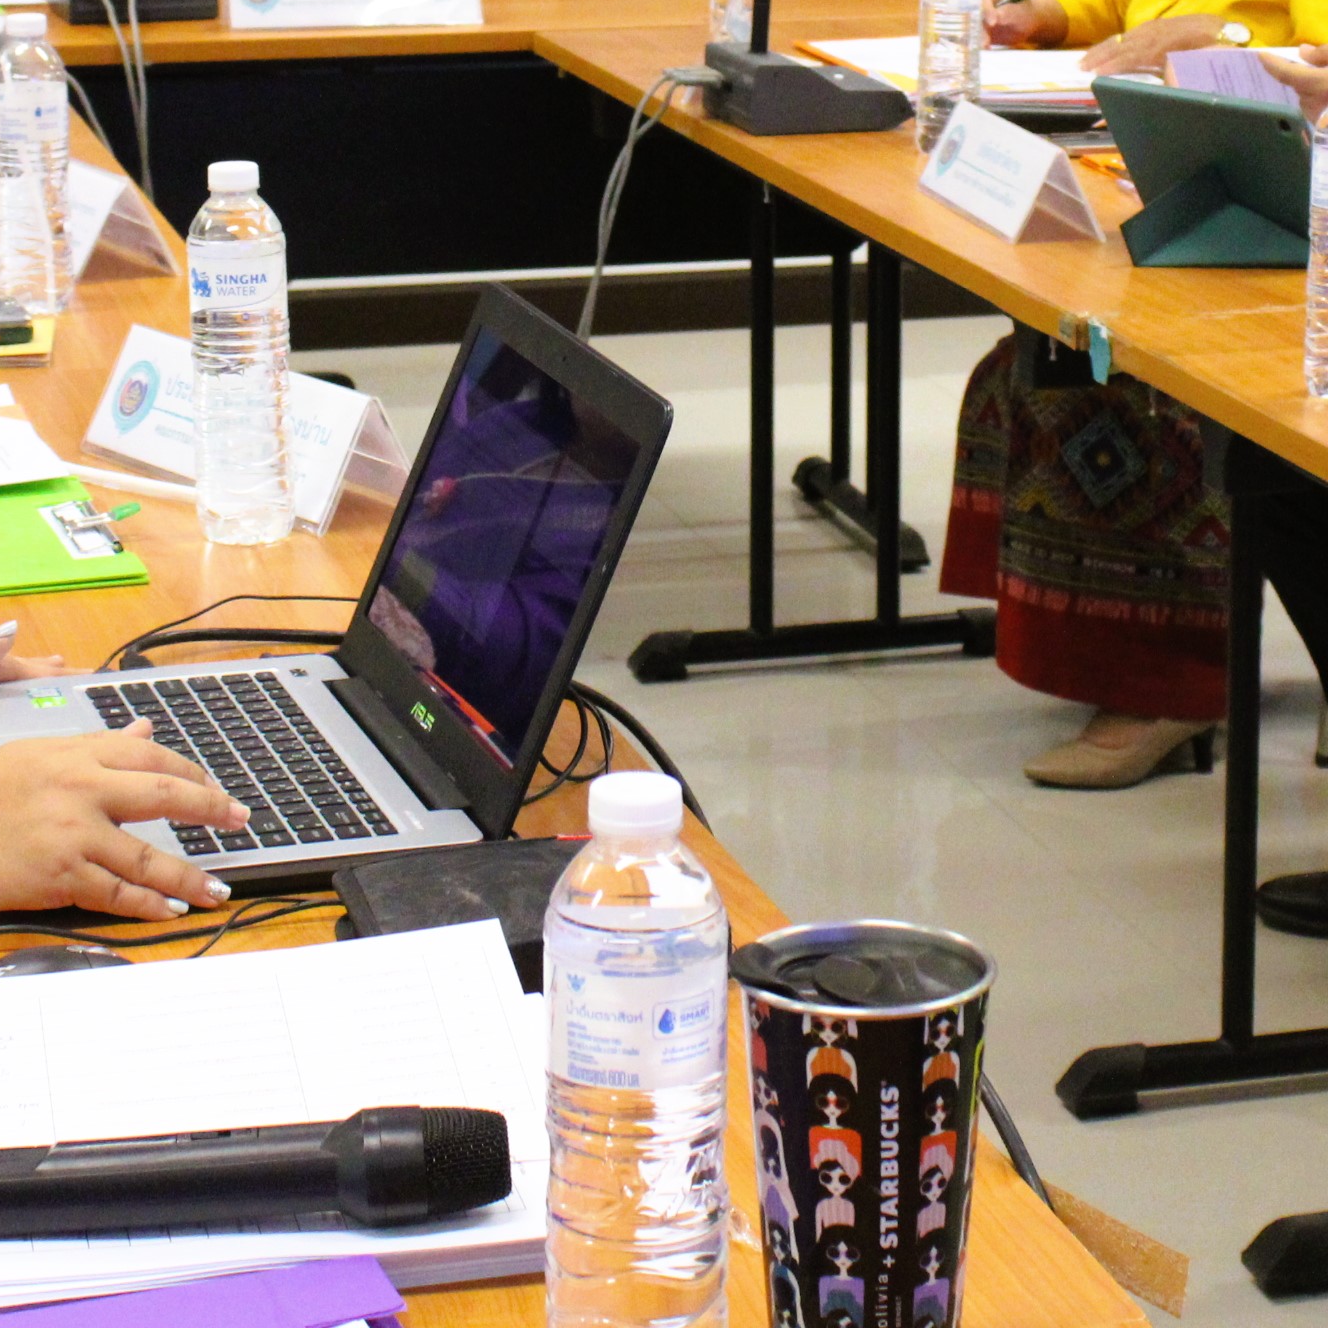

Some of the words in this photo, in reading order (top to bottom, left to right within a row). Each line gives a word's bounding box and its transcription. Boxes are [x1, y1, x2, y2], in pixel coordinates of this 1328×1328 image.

[215, 273, 267, 285] SINGHA
[216, 285, 257, 297] WATER
[679, 1004, 711, 1022] SMART
[879, 1084, 900, 1249] STARBUCKS
[875, 1273, 889, 1328] olivia
